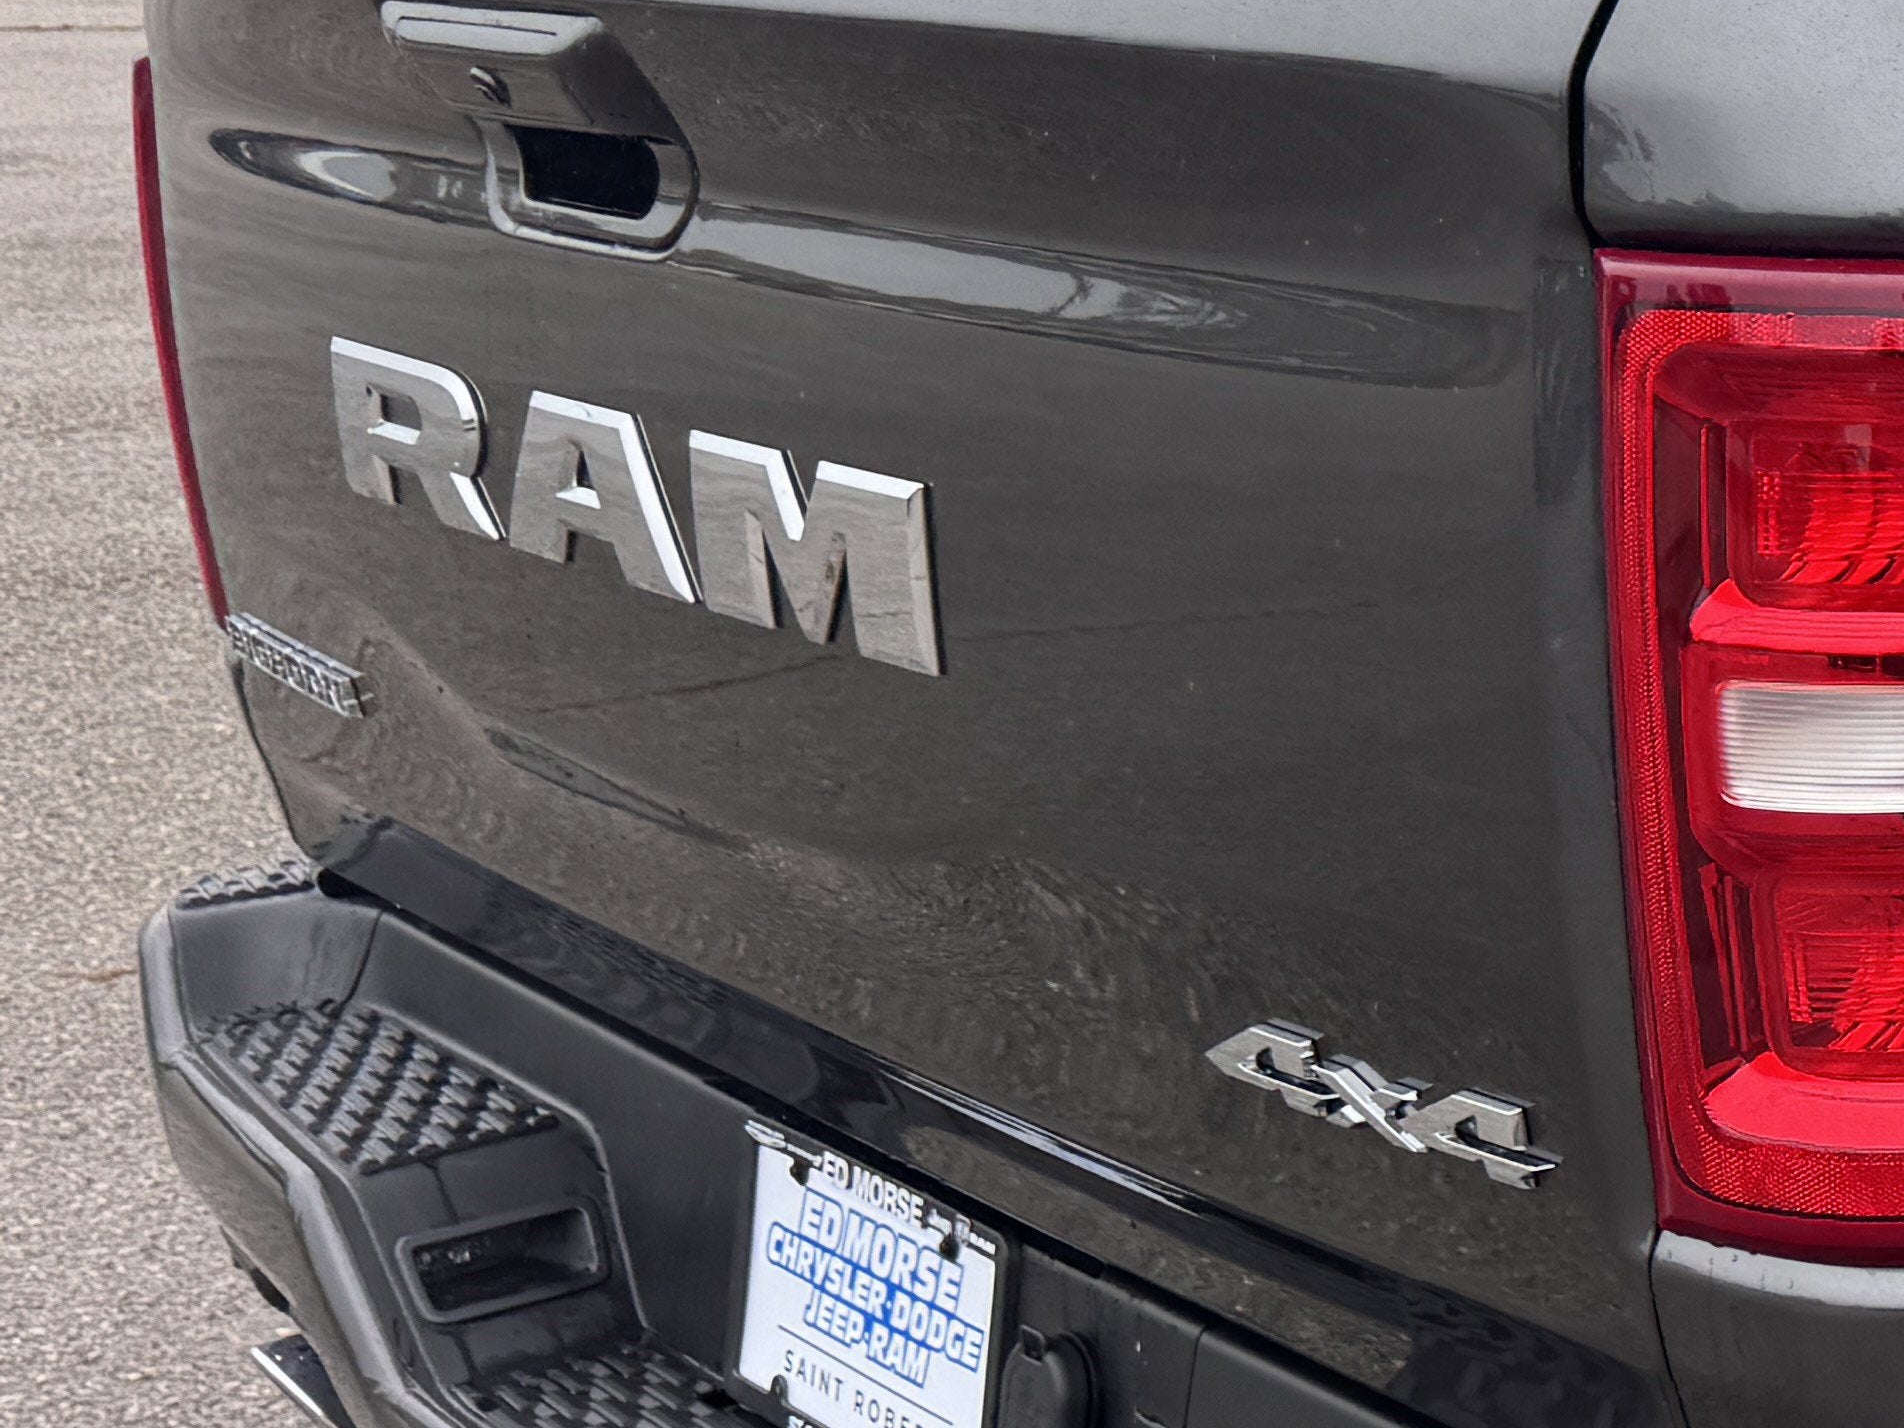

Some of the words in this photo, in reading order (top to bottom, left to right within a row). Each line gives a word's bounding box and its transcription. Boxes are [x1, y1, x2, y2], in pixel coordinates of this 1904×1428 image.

[331, 335, 948, 677] RAM
[822, 1150, 851, 1192] ED
[852, 1165, 925, 1230] MORSE
[801, 1188, 844, 1254] ED
[844, 1209, 964, 1315] MORSE
[784, 1349, 844, 1402] SAINT
